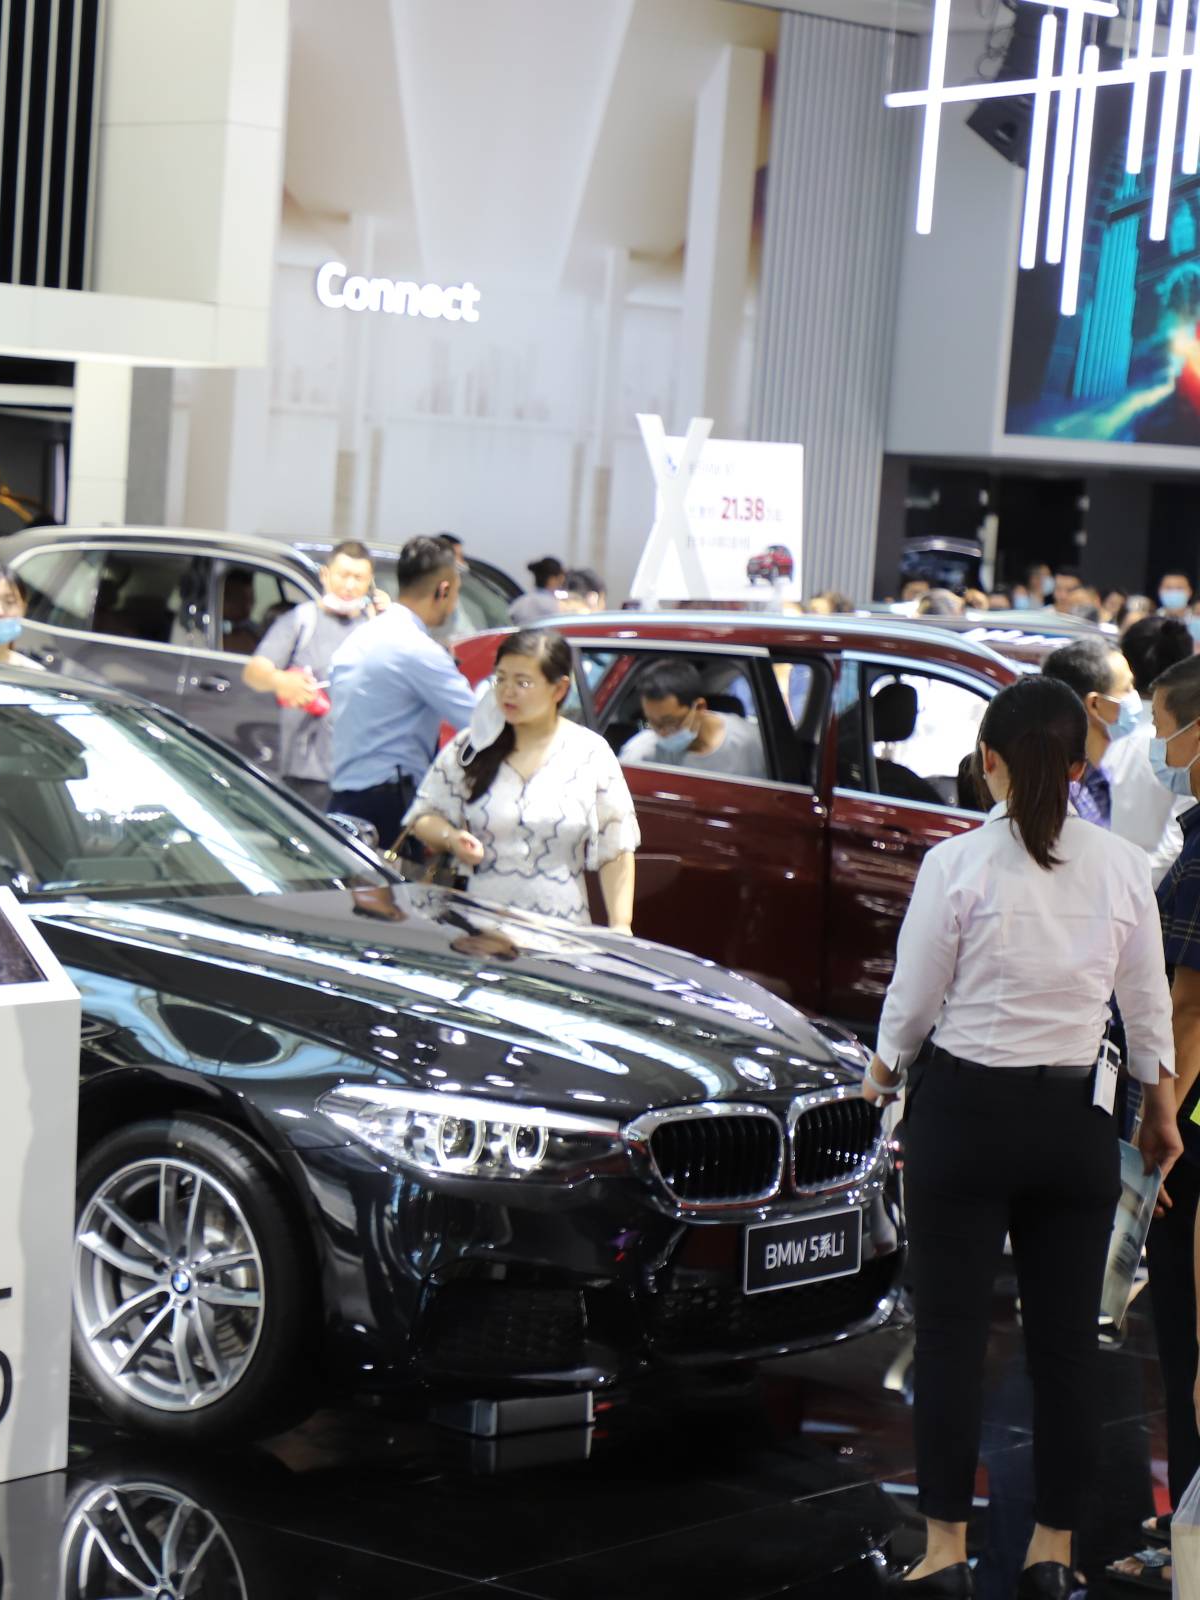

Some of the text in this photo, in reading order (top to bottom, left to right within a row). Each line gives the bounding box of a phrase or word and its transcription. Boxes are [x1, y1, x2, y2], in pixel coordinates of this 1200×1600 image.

[316, 261, 481, 322] Connect
[720, 496, 765, 521] 21.38
[764, 1231, 845, 1270] BMW 5系Li
